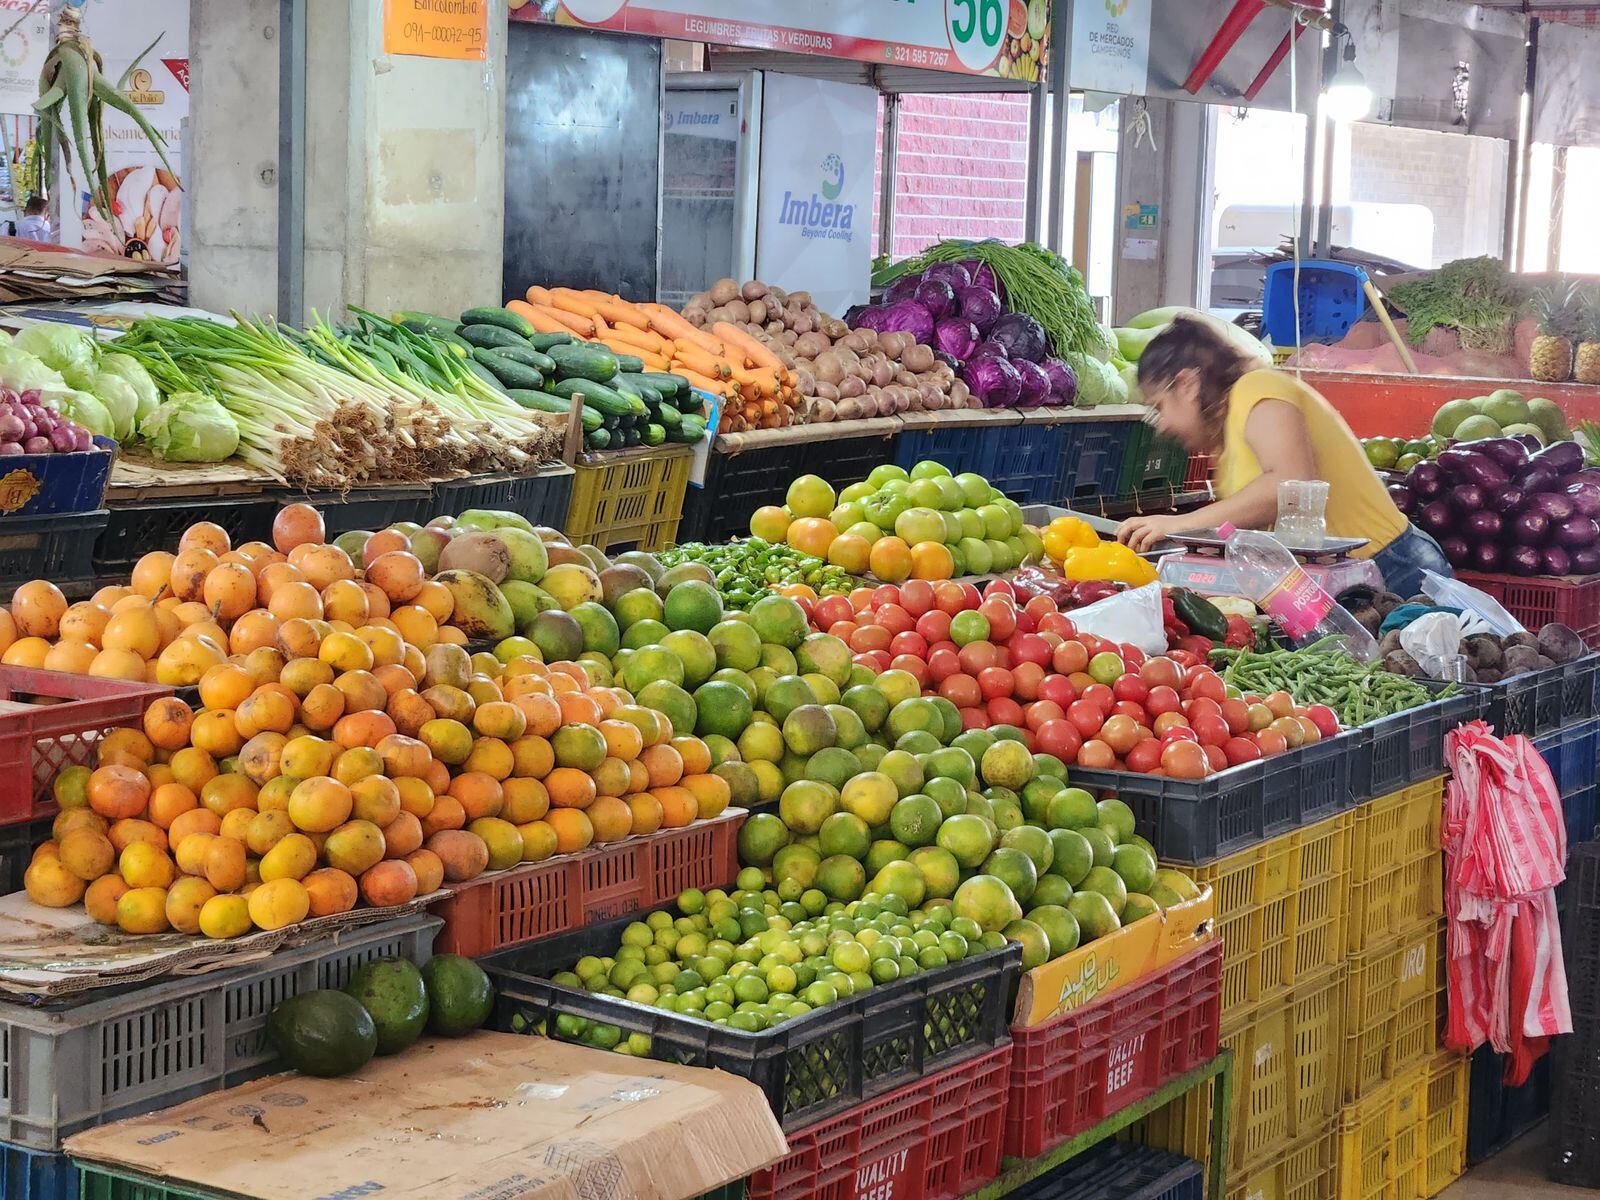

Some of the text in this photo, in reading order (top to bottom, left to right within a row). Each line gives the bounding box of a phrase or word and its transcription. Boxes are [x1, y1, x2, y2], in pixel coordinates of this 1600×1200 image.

[1089, 31, 1135, 48] DE MERCADOS
[895, 46, 910, 61] 321
[929, 51, 949, 66] 7267
[677, 110, 720, 126] Imbera
[779, 191, 854, 229] Imbera
[801, 227, 853, 243] Beyond Cooling
[1059, 950, 1097, 1004] AJO
[1107, 1060, 1134, 1095] BEEF
